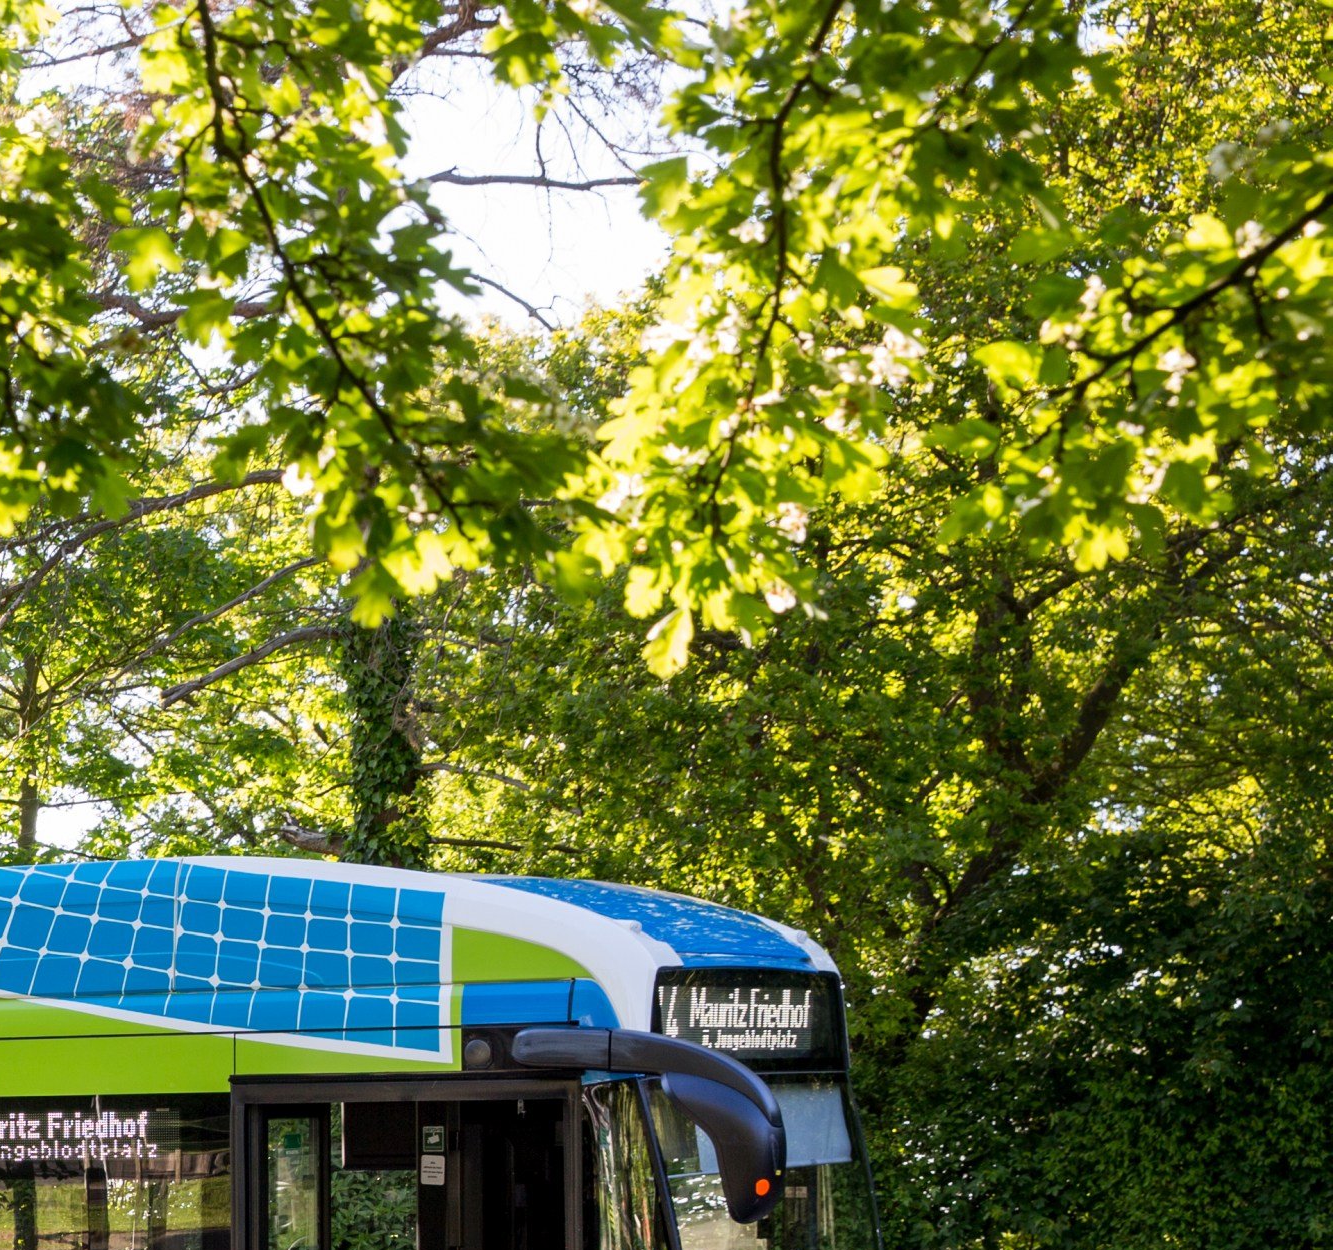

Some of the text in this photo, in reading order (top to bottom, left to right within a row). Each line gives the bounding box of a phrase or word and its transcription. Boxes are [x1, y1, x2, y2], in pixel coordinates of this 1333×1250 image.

[689, 986, 748, 1028] Mauritz
[748, 987, 812, 1029] Friedhof
[46, 1110, 148, 1139] Friedhof
